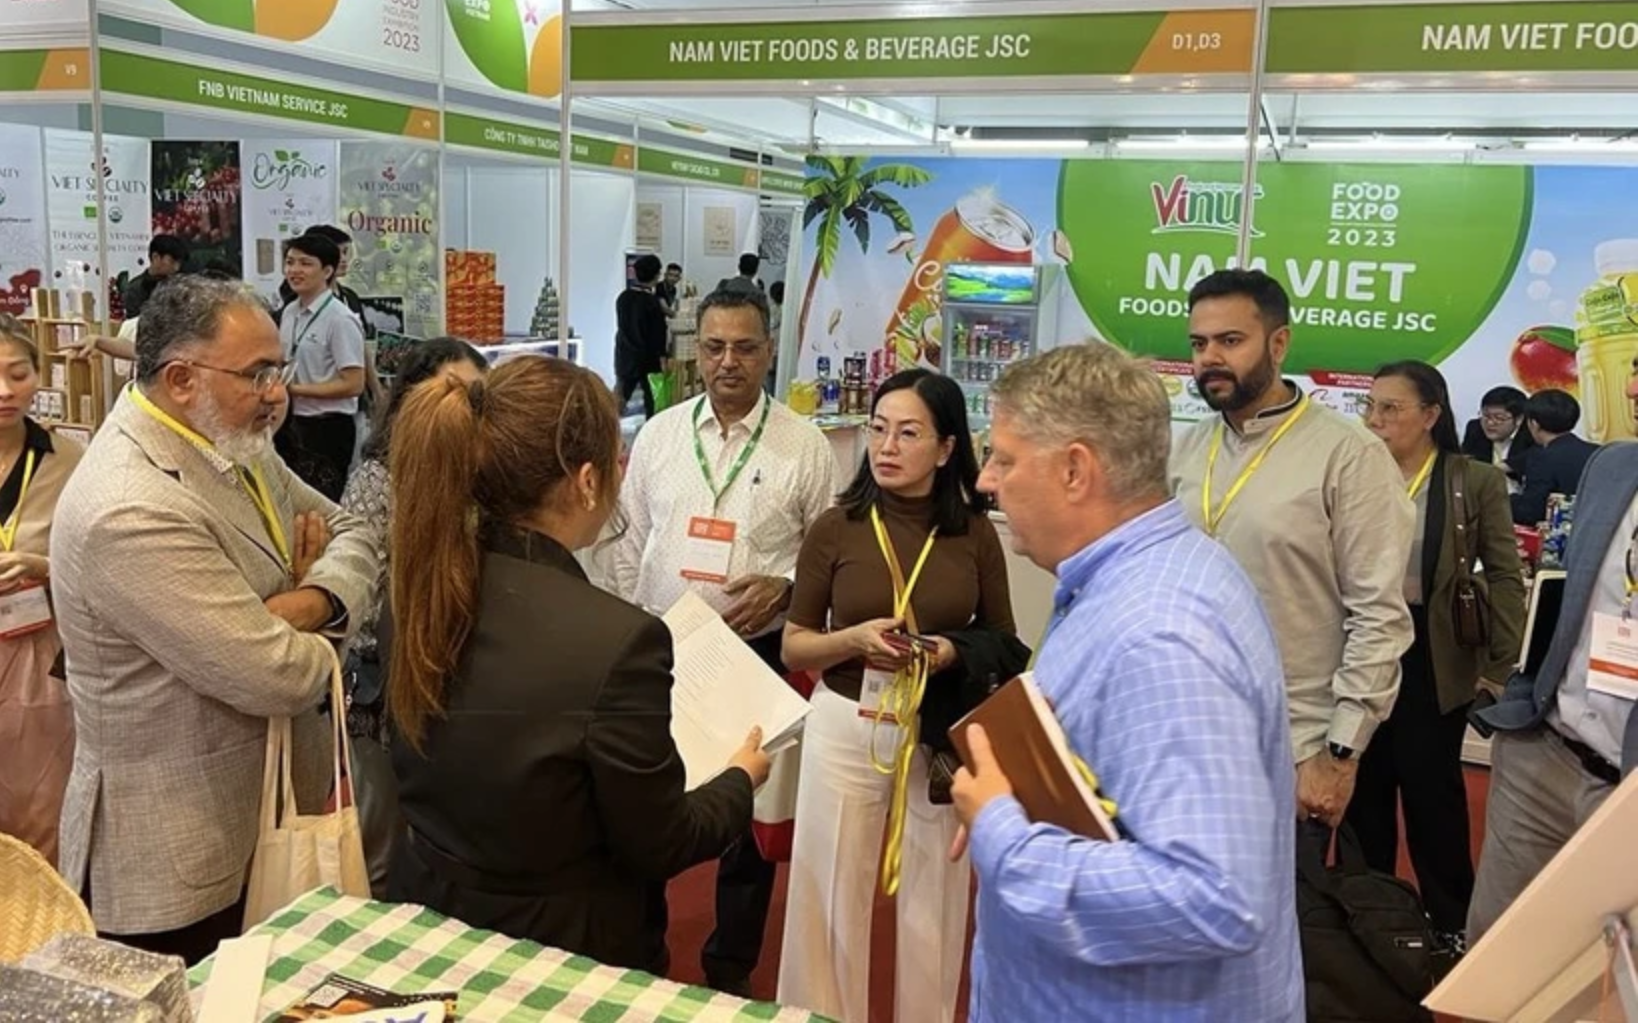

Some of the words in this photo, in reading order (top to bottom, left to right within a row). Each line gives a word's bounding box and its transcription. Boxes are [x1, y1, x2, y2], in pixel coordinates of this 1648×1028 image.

[383, 28, 420, 52] 2023
[669, 41, 715, 62] NAM
[720, 40, 764, 62] VIET
[768, 38, 839, 61] FOODS
[843, 38, 859, 60] &
[865, 35, 980, 60] BEVERAGE
[985, 34, 1031, 58] JSC
[1172, 33, 1221, 52] D1,D3
[1421, 25, 1491, 50] NAM
[1500, 24, 1568, 50] VIET
[200, 80, 225, 98] FNB
[226, 84, 280, 107] VIETNAM
[281, 94, 327, 115] SERVICE
[328, 102, 349, 118] JSC
[252, 152, 327, 191] Organic
[86, 177, 149, 194] SCIALTY
[1332, 182, 1401, 201] FOOD
[347, 209, 432, 237] Organic
[1331, 202, 1399, 221] EXPO
[1327, 228, 1396, 247] 2023
[1286, 258, 1416, 303] VIET
[1290, 306, 1386, 330] VERAGE
[1391, 312, 1436, 332] JSC
